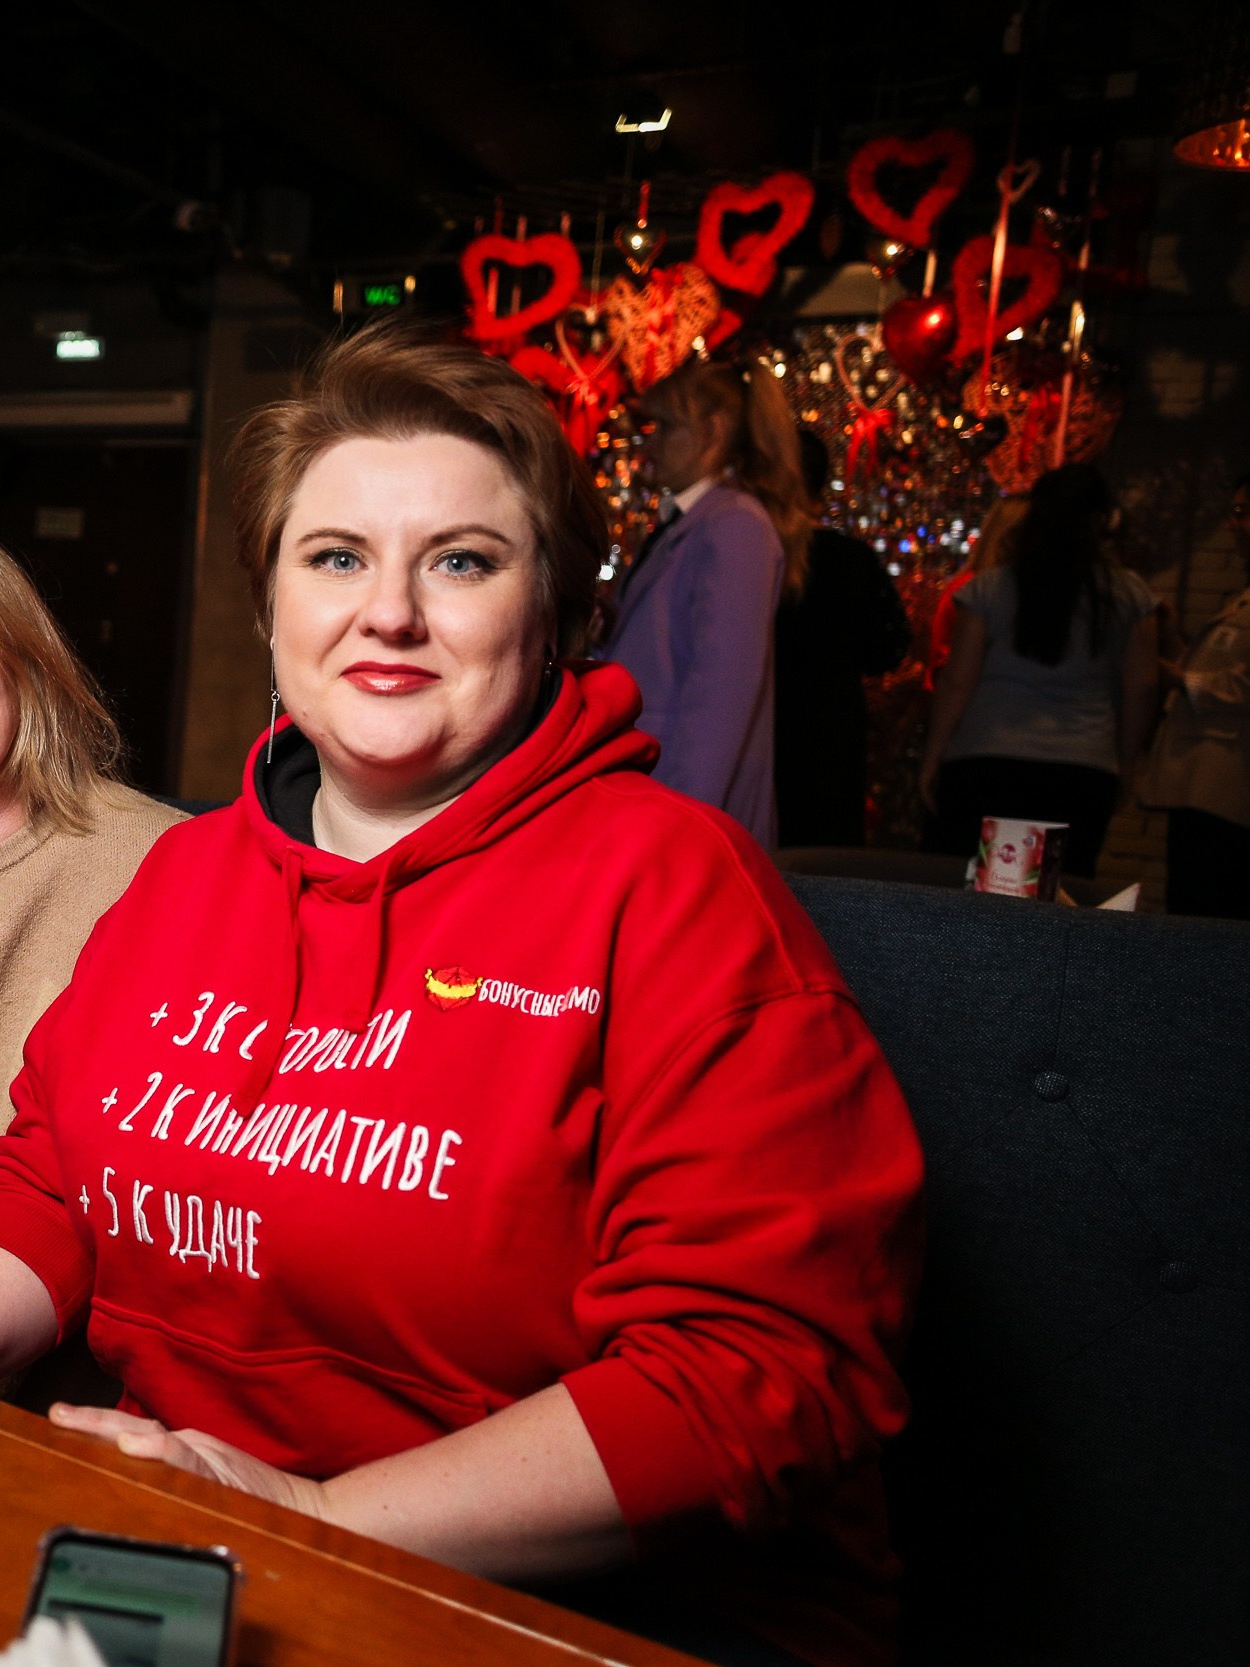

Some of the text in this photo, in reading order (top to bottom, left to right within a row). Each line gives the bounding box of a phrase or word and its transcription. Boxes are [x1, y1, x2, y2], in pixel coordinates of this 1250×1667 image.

[478, 978, 565, 1017] БОНУСНЫЕ
[183, 1091, 463, 1201] ИНИЦИАТИВЕ
[132, 1179, 154, 1246] К
[164, 1190, 263, 1281] УДАЧЕ
